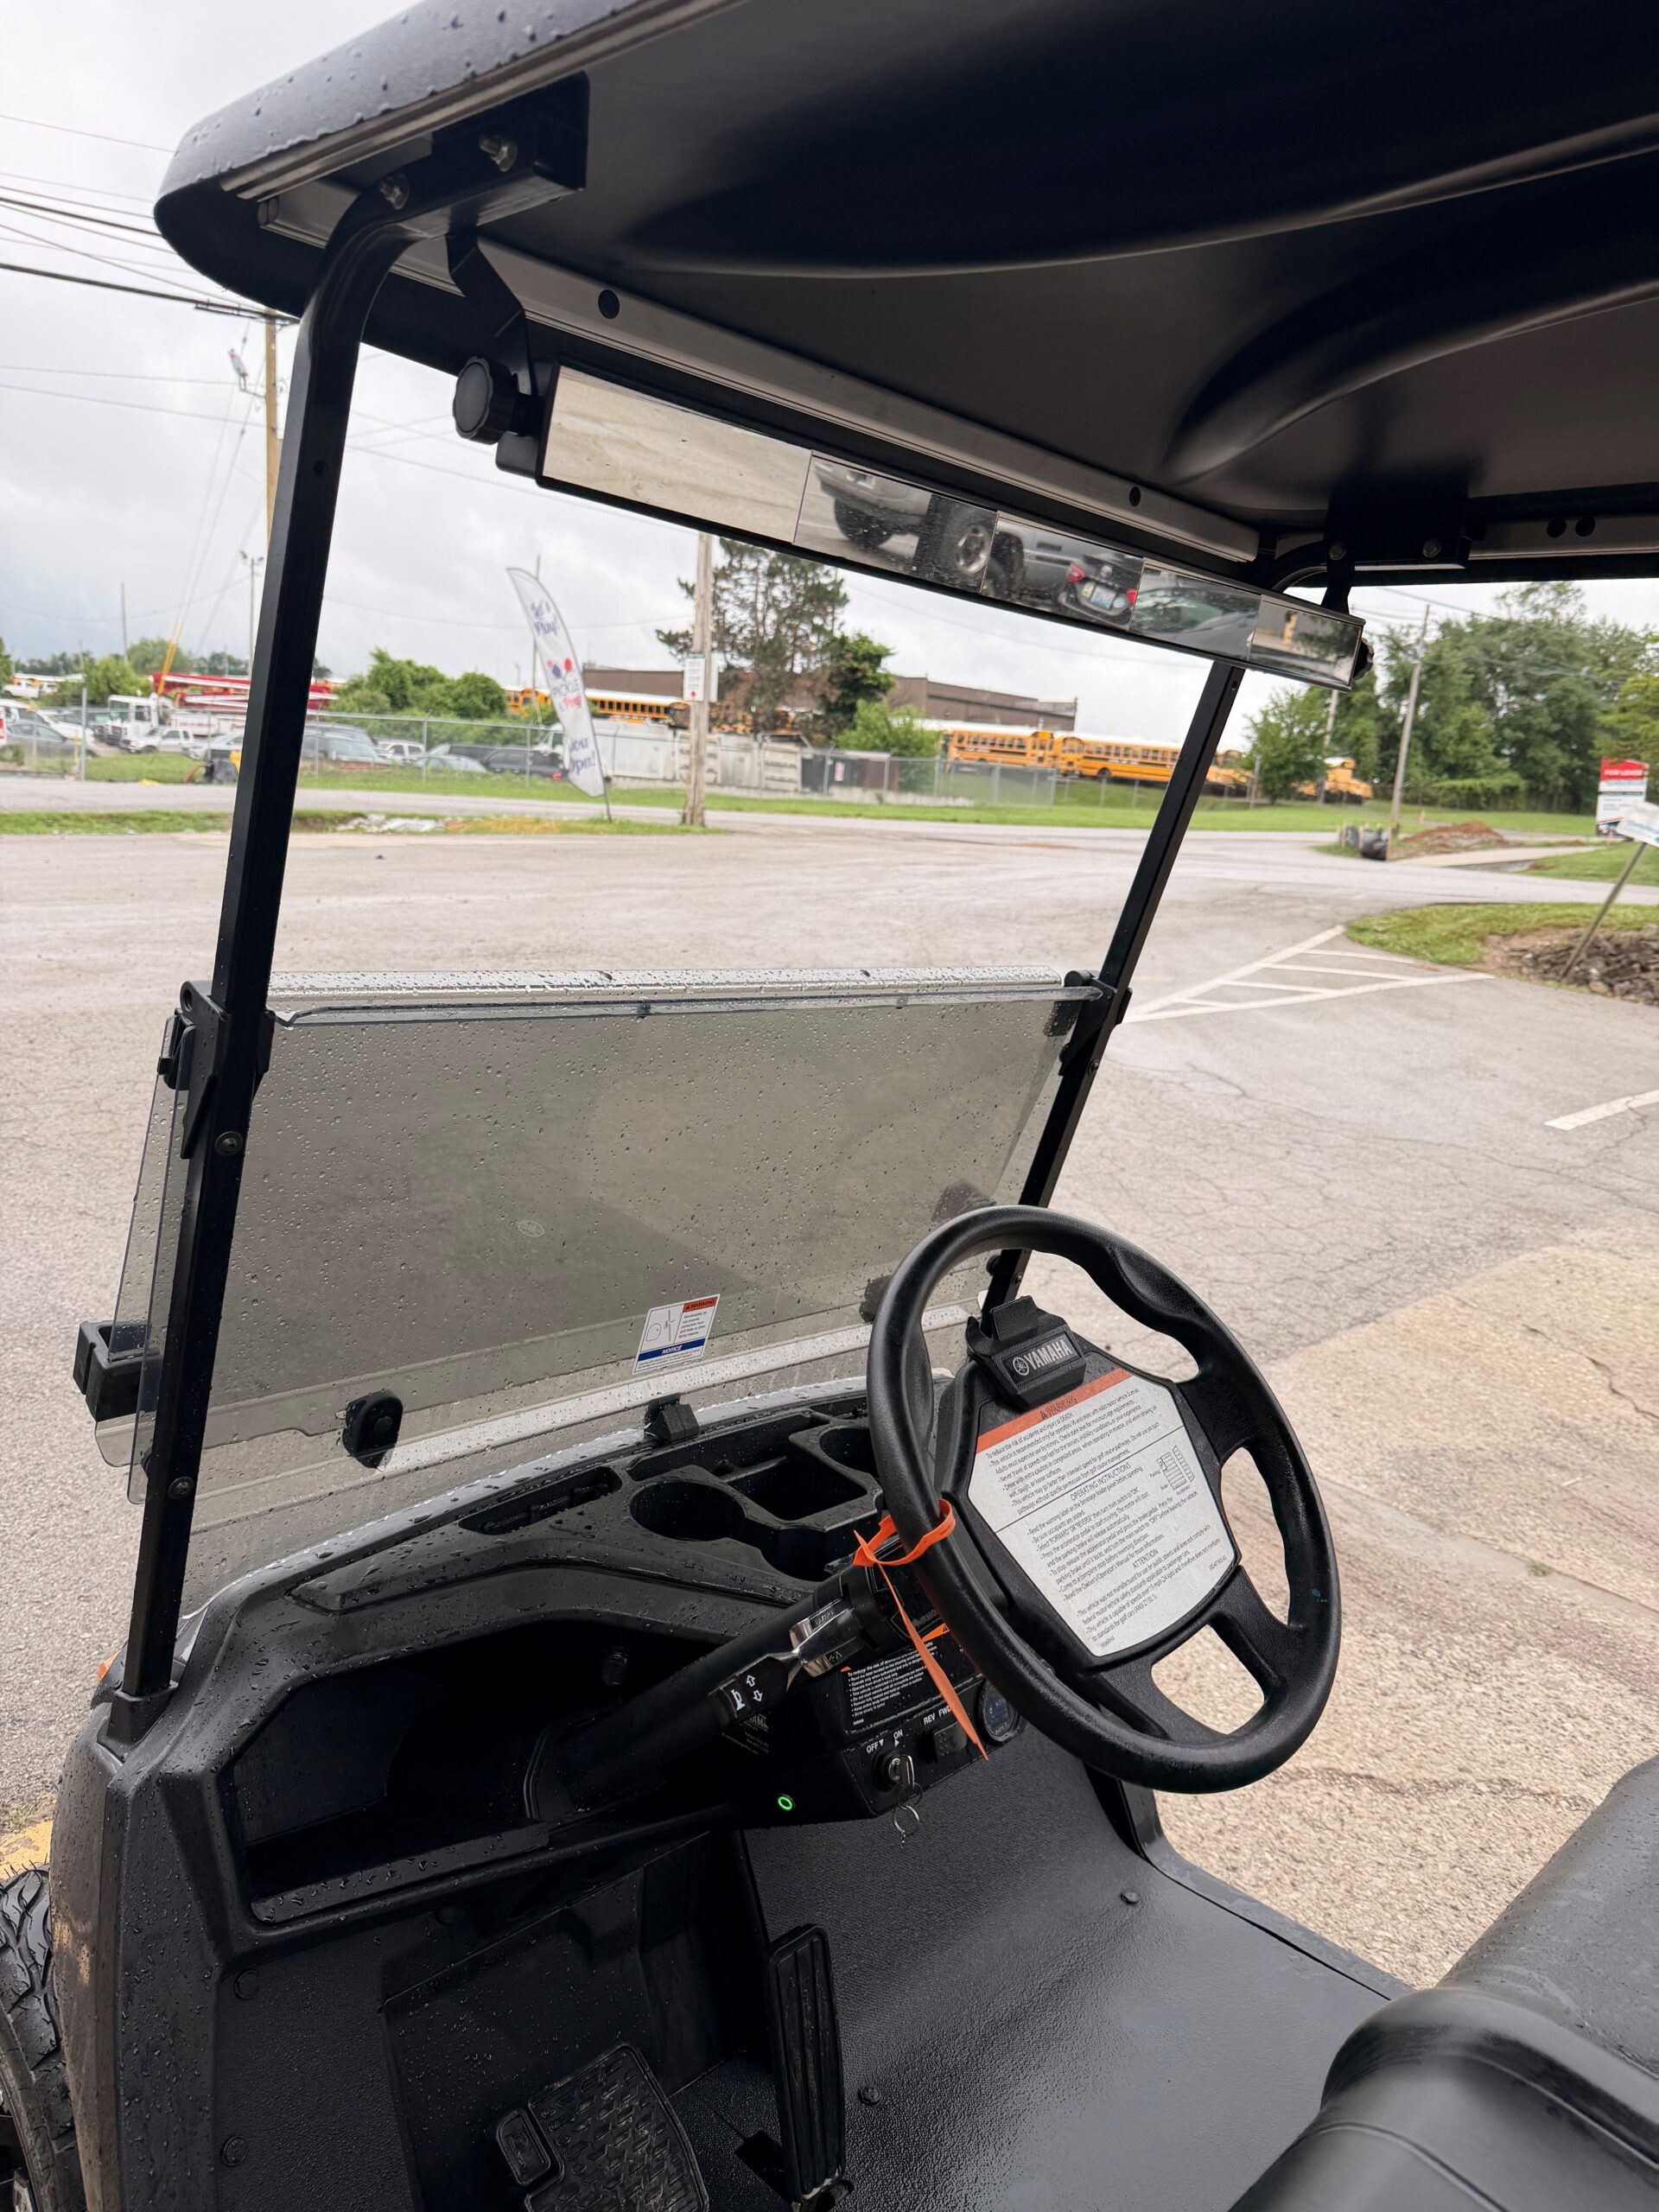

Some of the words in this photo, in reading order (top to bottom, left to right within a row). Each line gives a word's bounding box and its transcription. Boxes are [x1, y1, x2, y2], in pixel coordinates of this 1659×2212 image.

[691, 1300, 715, 1308] WARNING
[661, 1345, 683, 1355] NOTICE
[1023, 1339, 1071, 1370] YAMAHA
[1047, 1396, 1077, 1416] WARNING
[1070, 1481, 1098, 1501] OPERATING
[1097, 1462, 1131, 1485] INSTRUCTIONS
[1047, 1521, 1066, 1535] occupants
[1132, 1548, 1159, 1569] ATTENTION
[923, 1713, 936, 1726] REV
[893, 1729, 903, 1739] ON
[866, 1742, 879, 1754] OFF
